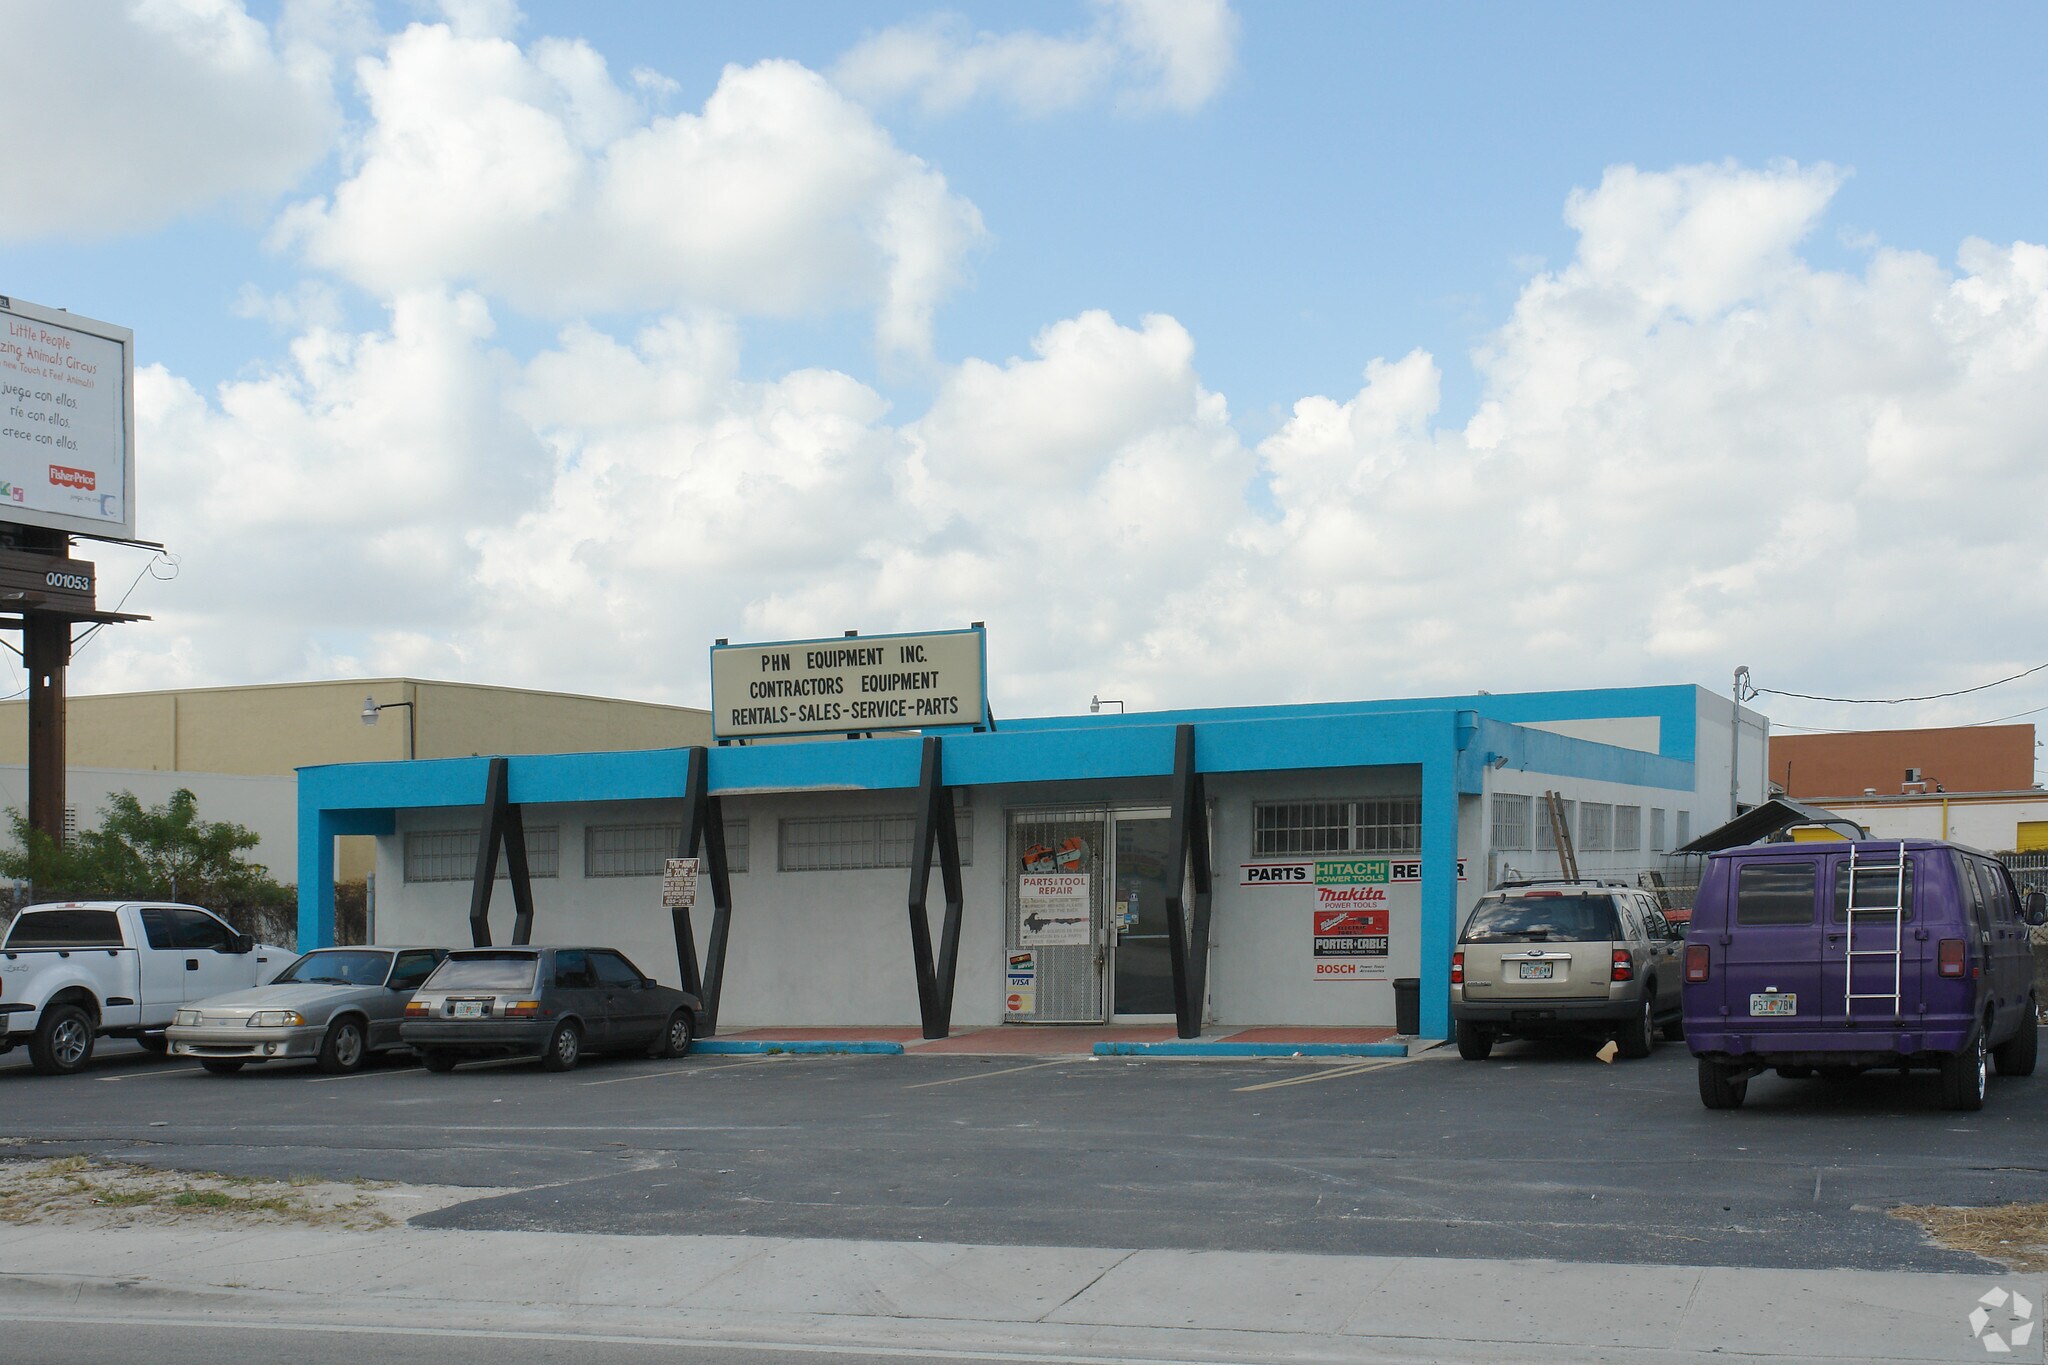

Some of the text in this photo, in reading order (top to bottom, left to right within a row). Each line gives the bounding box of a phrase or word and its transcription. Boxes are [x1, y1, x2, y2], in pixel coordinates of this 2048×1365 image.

[10, 322, 71, 350] Little People
[27, 346, 62, 366] Animals
[66, 356, 97, 375] Circus
[20, 362, 41, 375] Touch
[49, 369, 64, 381] Feel
[1, 382, 78, 409] juega con ellos.
[28, 411, 46, 422] con
[48, 412, 71, 428] ellos.
[2, 428, 79, 451] crece con ellos.
[50, 467, 95, 485] Fisher-Price
[46, 572, 90, 591] 001053
[761, 645, 928, 672] PHN EQUIPMENT INC.
[750, 671, 939, 699] CONTRACTORS EQUIPMENT
[674, 868, 689, 877] ZONE
[1248, 867, 1306, 881] PARTS
[1316, 863, 1385, 875] HITACHI
[1023, 878, 1053, 886] PARTS
[1059, 877, 1086, 886] TOOL
[1316, 874, 1385, 883] POWER TOOLS
[1038, 886, 1073, 895] REPAIR
[1316, 964, 1356, 974] BOSCH
[1012, 978, 1030, 986] VISA
[1753, 1000, 1768, 1011] P53
